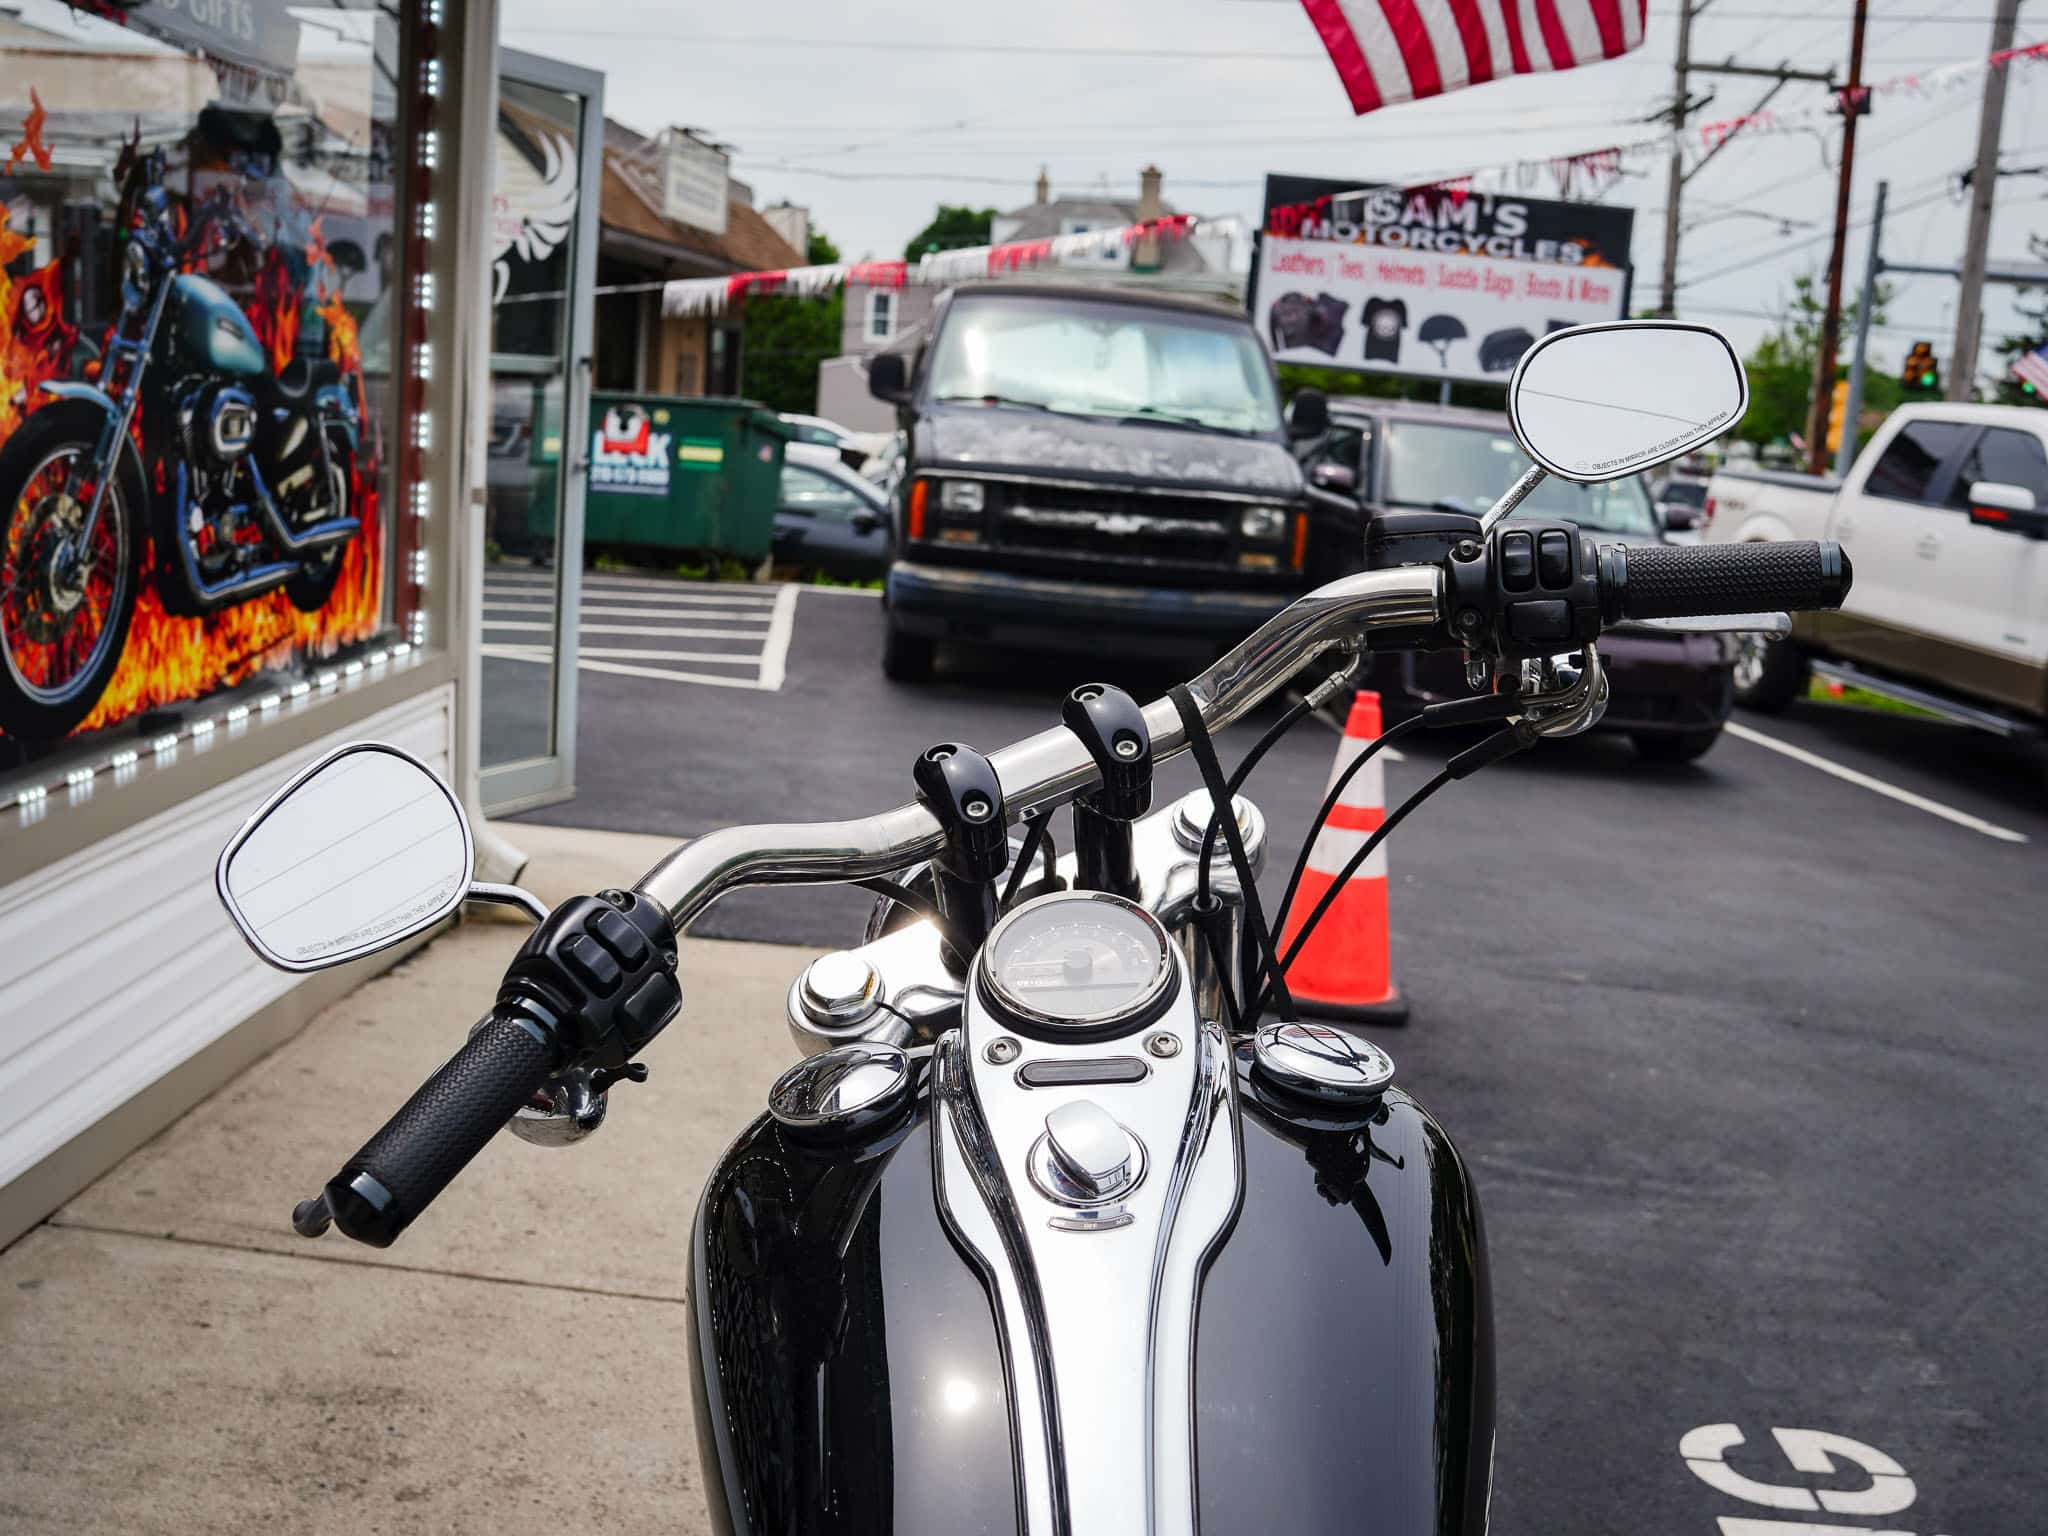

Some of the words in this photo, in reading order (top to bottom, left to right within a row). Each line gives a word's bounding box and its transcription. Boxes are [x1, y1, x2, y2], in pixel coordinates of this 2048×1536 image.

[189, 0, 254, 40] GIFTS
[1364, 190, 1528, 237] SAM'S
[1301, 217, 1584, 265] MOTORCYCLES
[1592, 459, 1618, 470] OBJECTS
[1625, 450, 1646, 463] MIRROR
[1647, 446, 1658, 455] ARE
[1658, 437, 1680, 451] CLOSER
[1680, 430, 1695, 441] THAN
[1694, 424, 1708, 434] THEY
[1707, 411, 1727, 426] APPEAR
